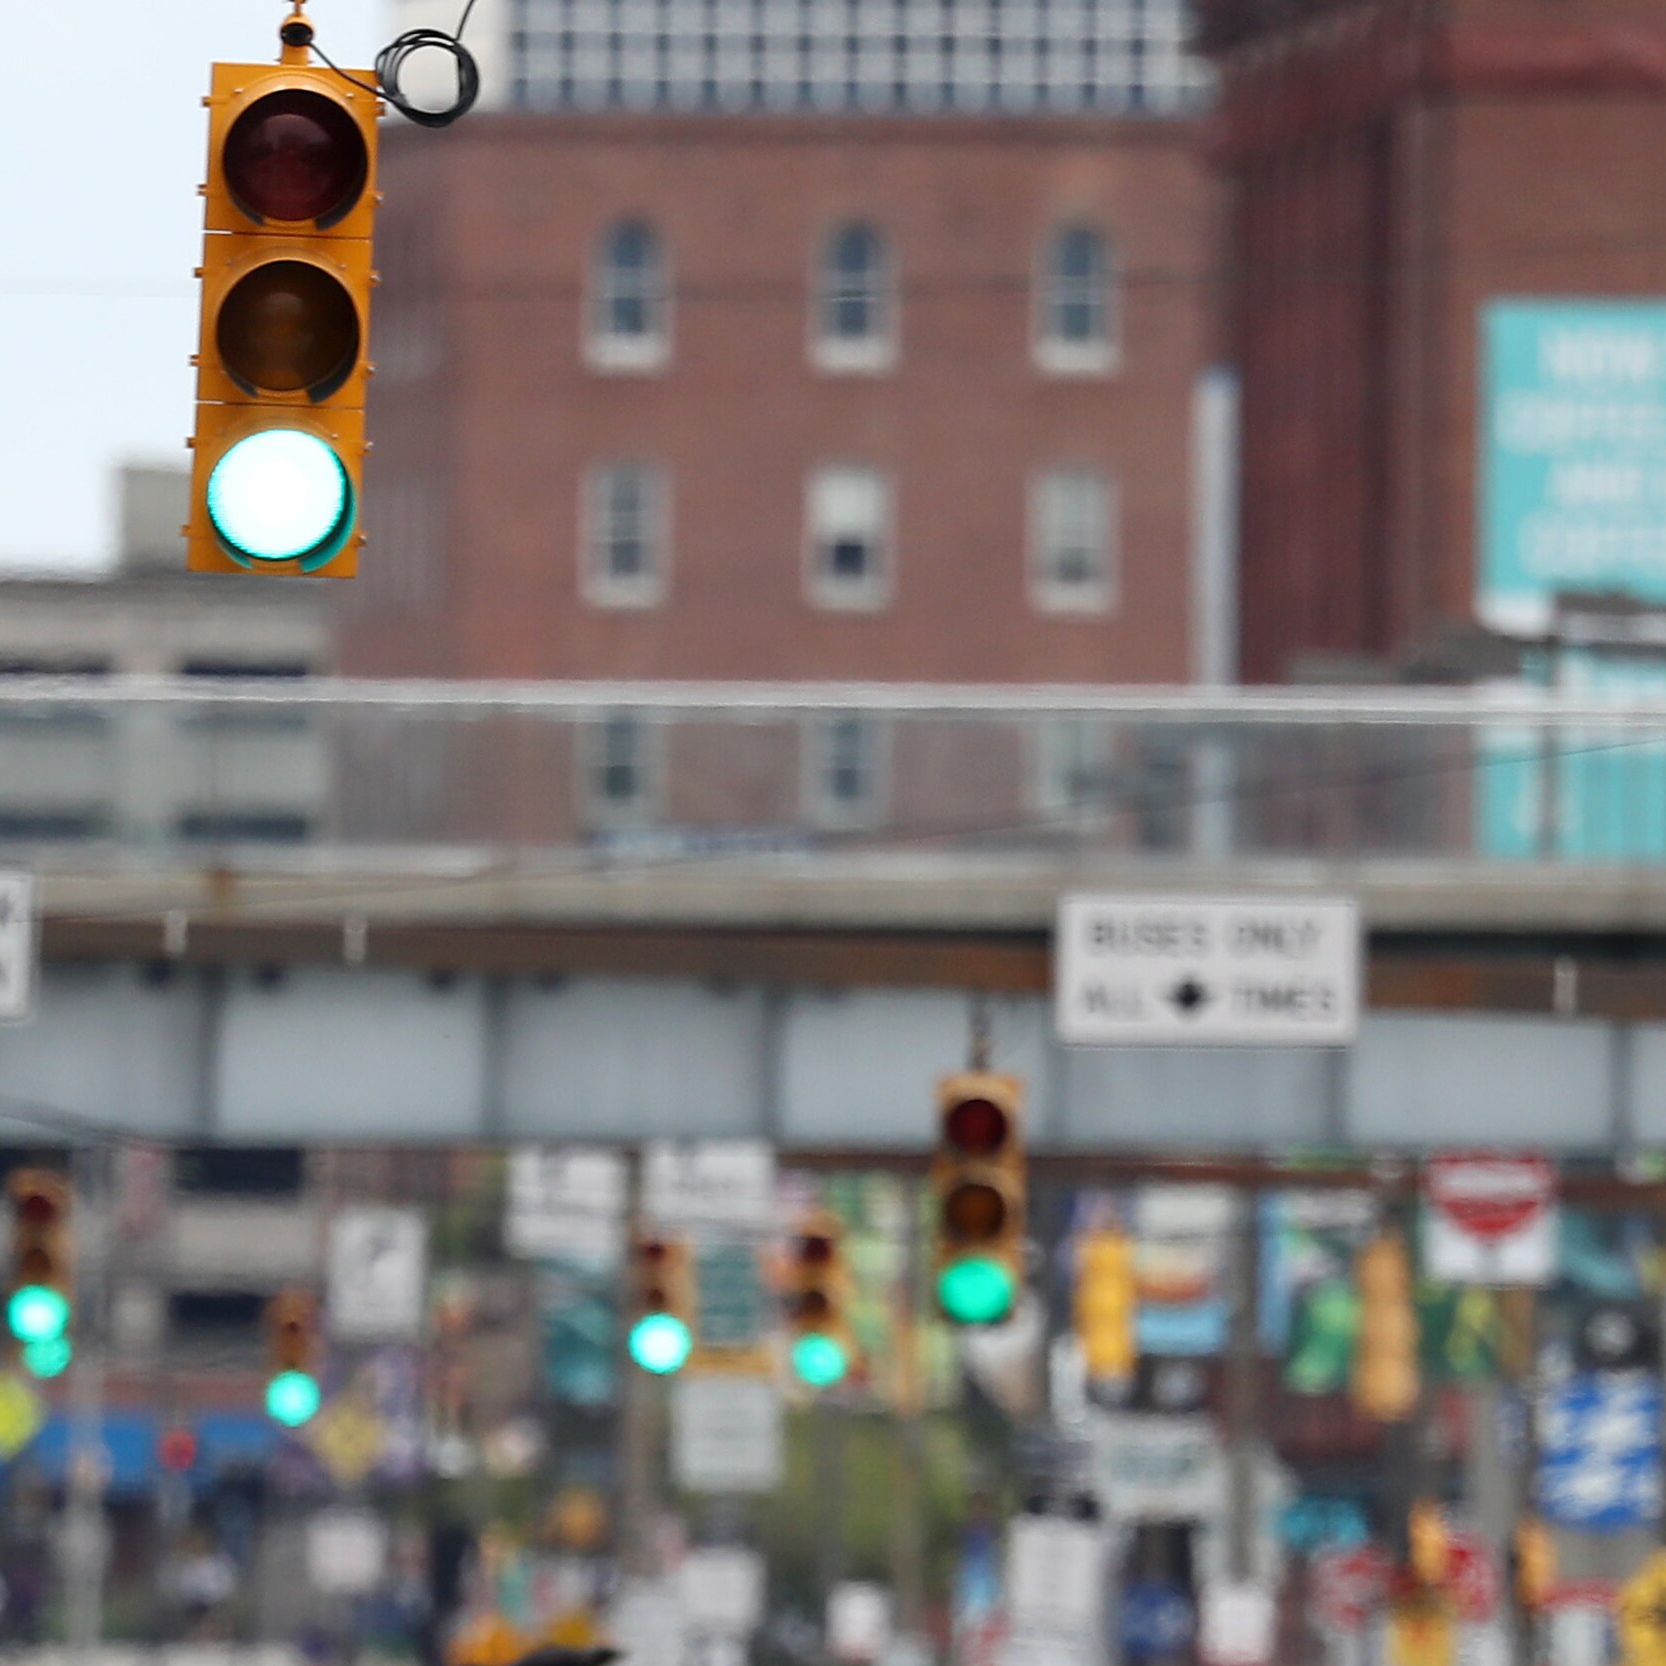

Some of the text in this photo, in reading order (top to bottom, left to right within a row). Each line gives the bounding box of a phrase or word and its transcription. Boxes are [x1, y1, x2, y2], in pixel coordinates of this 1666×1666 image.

[1087, 916, 1323, 956] BUSES ONLY
[1081, 982, 1341, 1019] ALL TIMES
